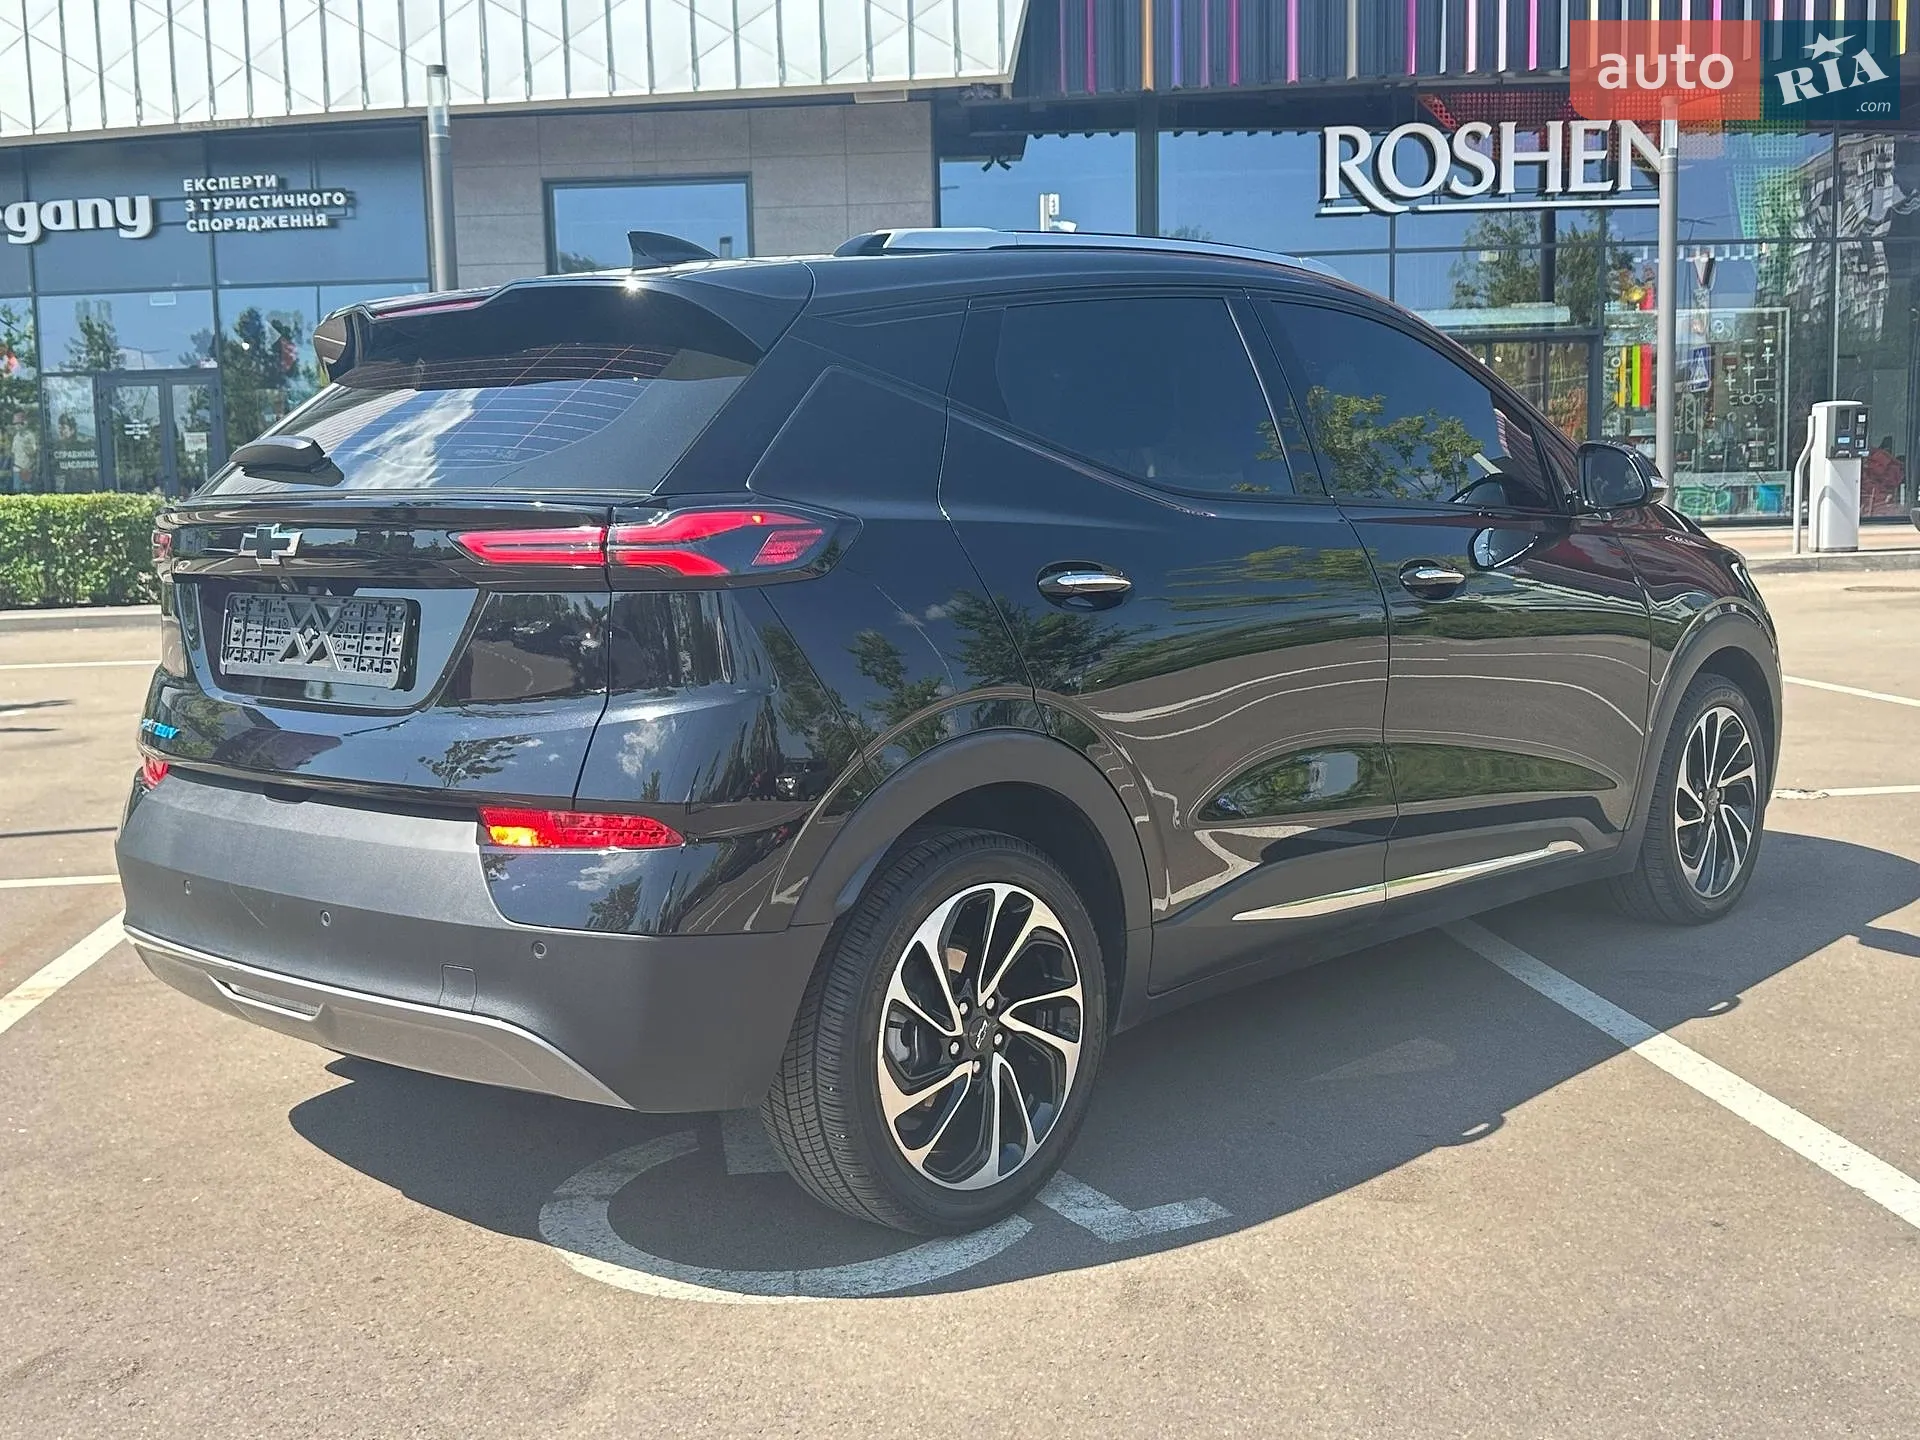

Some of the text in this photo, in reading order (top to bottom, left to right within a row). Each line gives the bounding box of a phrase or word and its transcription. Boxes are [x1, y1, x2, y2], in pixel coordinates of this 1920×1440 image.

[1323, 120, 1661, 213] ROSHEN
[183, 174, 277, 192] ЕКСПЕРТИ
[200, 191, 347, 212] ТУРИСТИЧНОГО
[0, 195, 153, 244] gany
[186, 213, 329, 232] СПОРЯДЖЕННЯ
